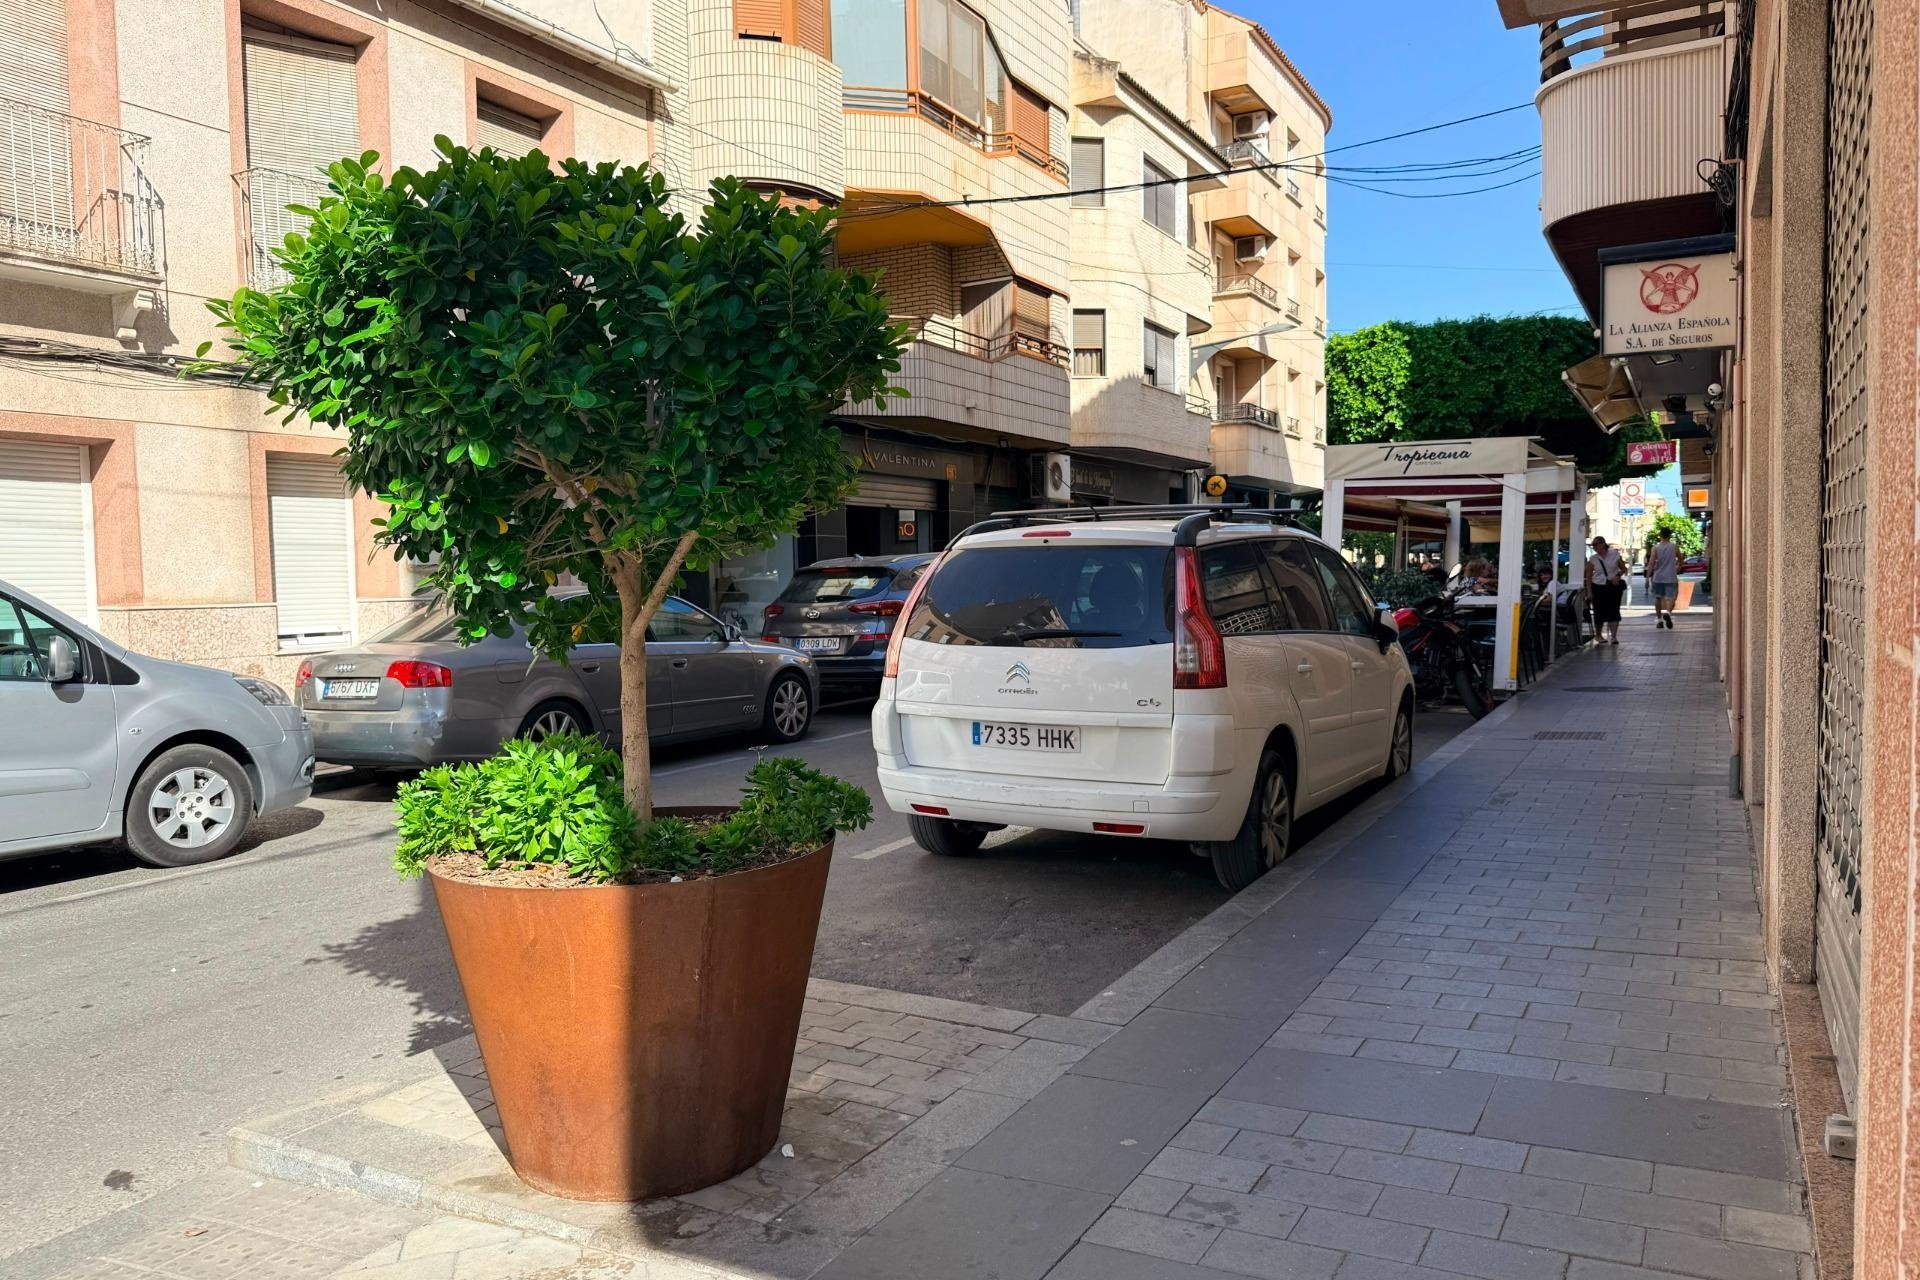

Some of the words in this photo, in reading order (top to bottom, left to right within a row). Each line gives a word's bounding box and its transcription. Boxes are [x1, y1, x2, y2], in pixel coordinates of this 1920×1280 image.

[1609, 324, 1624, 336] LA
[1629, 322, 1672, 334] ALIANZA
[1678, 317, 1730, 329] ESPAÑOLA
[1626, 338, 1647, 349] S.A.
[1652, 338, 1664, 347] DE
[1668, 333, 1713, 346] SEGUROS
[873, 451, 936, 468] VALENTINA
[1378, 441, 1473, 475] Tropicana
[801, 639, 820, 648] 0309
[330, 681, 353, 694] 6767
[355, 681, 377, 693] DXF
[984, 725, 1031, 747] 7335
[1037, 728, 1075, 750] HHK
